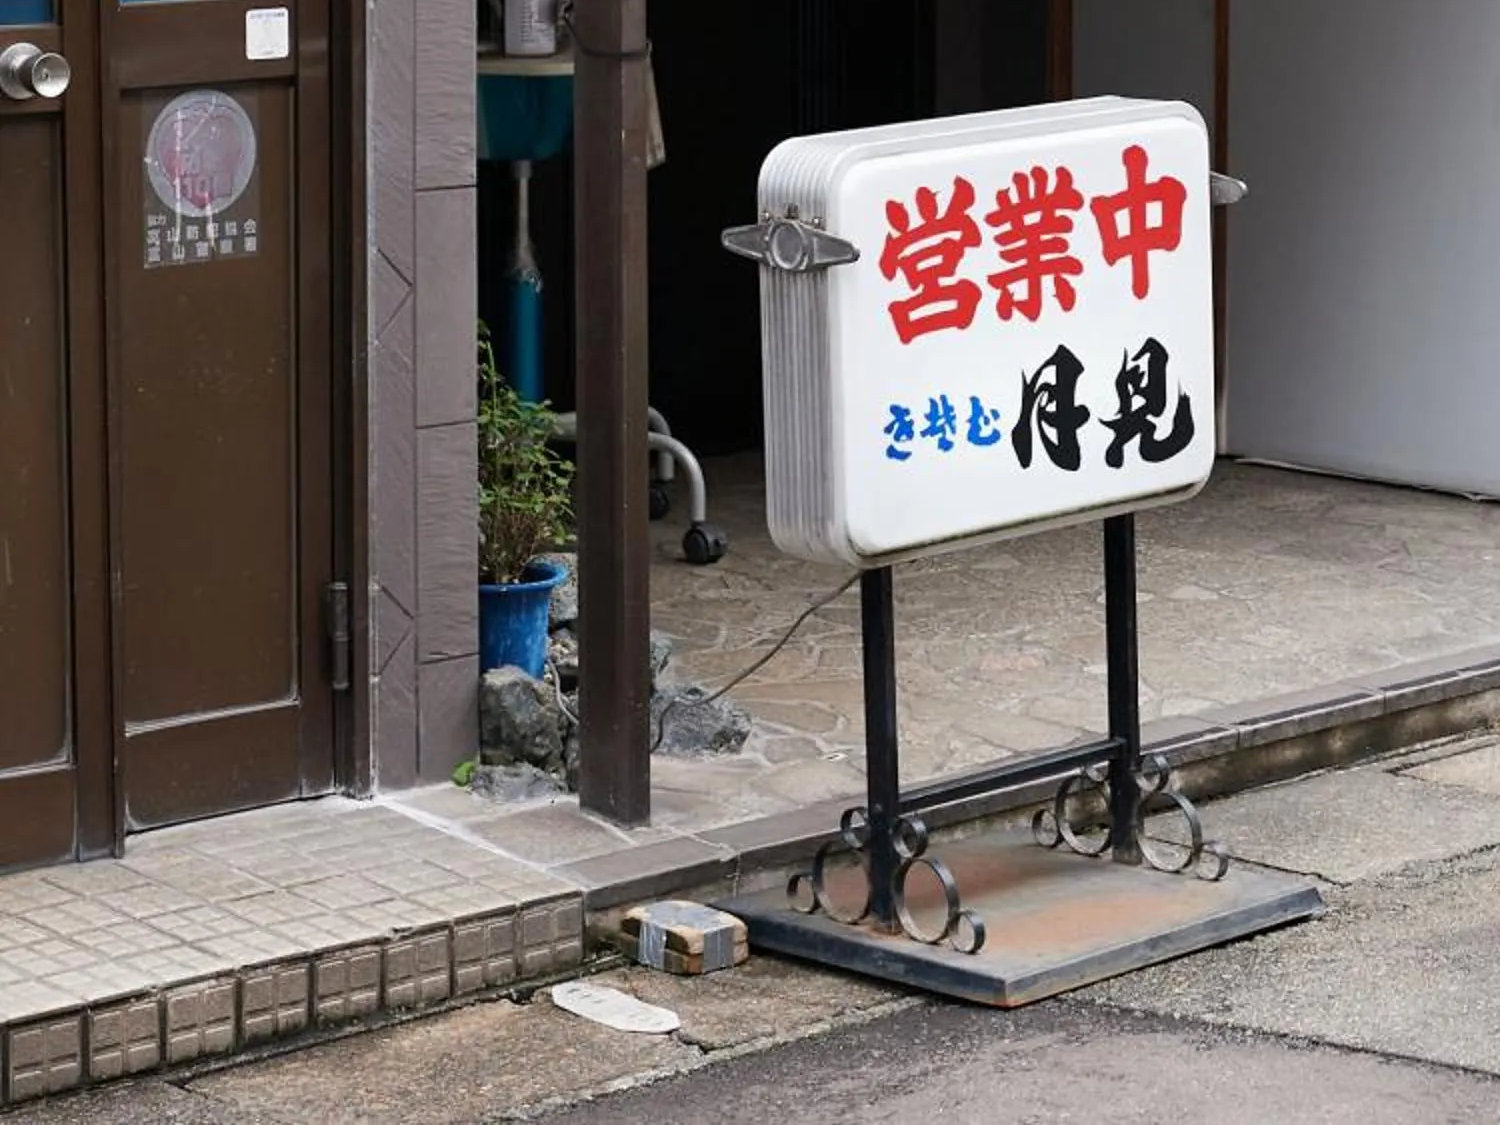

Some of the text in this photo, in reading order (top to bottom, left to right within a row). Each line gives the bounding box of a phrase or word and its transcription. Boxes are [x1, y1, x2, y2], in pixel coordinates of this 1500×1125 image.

[879, 144, 1187, 345] 営業中
[1011, 337, 1195, 472] 月見
